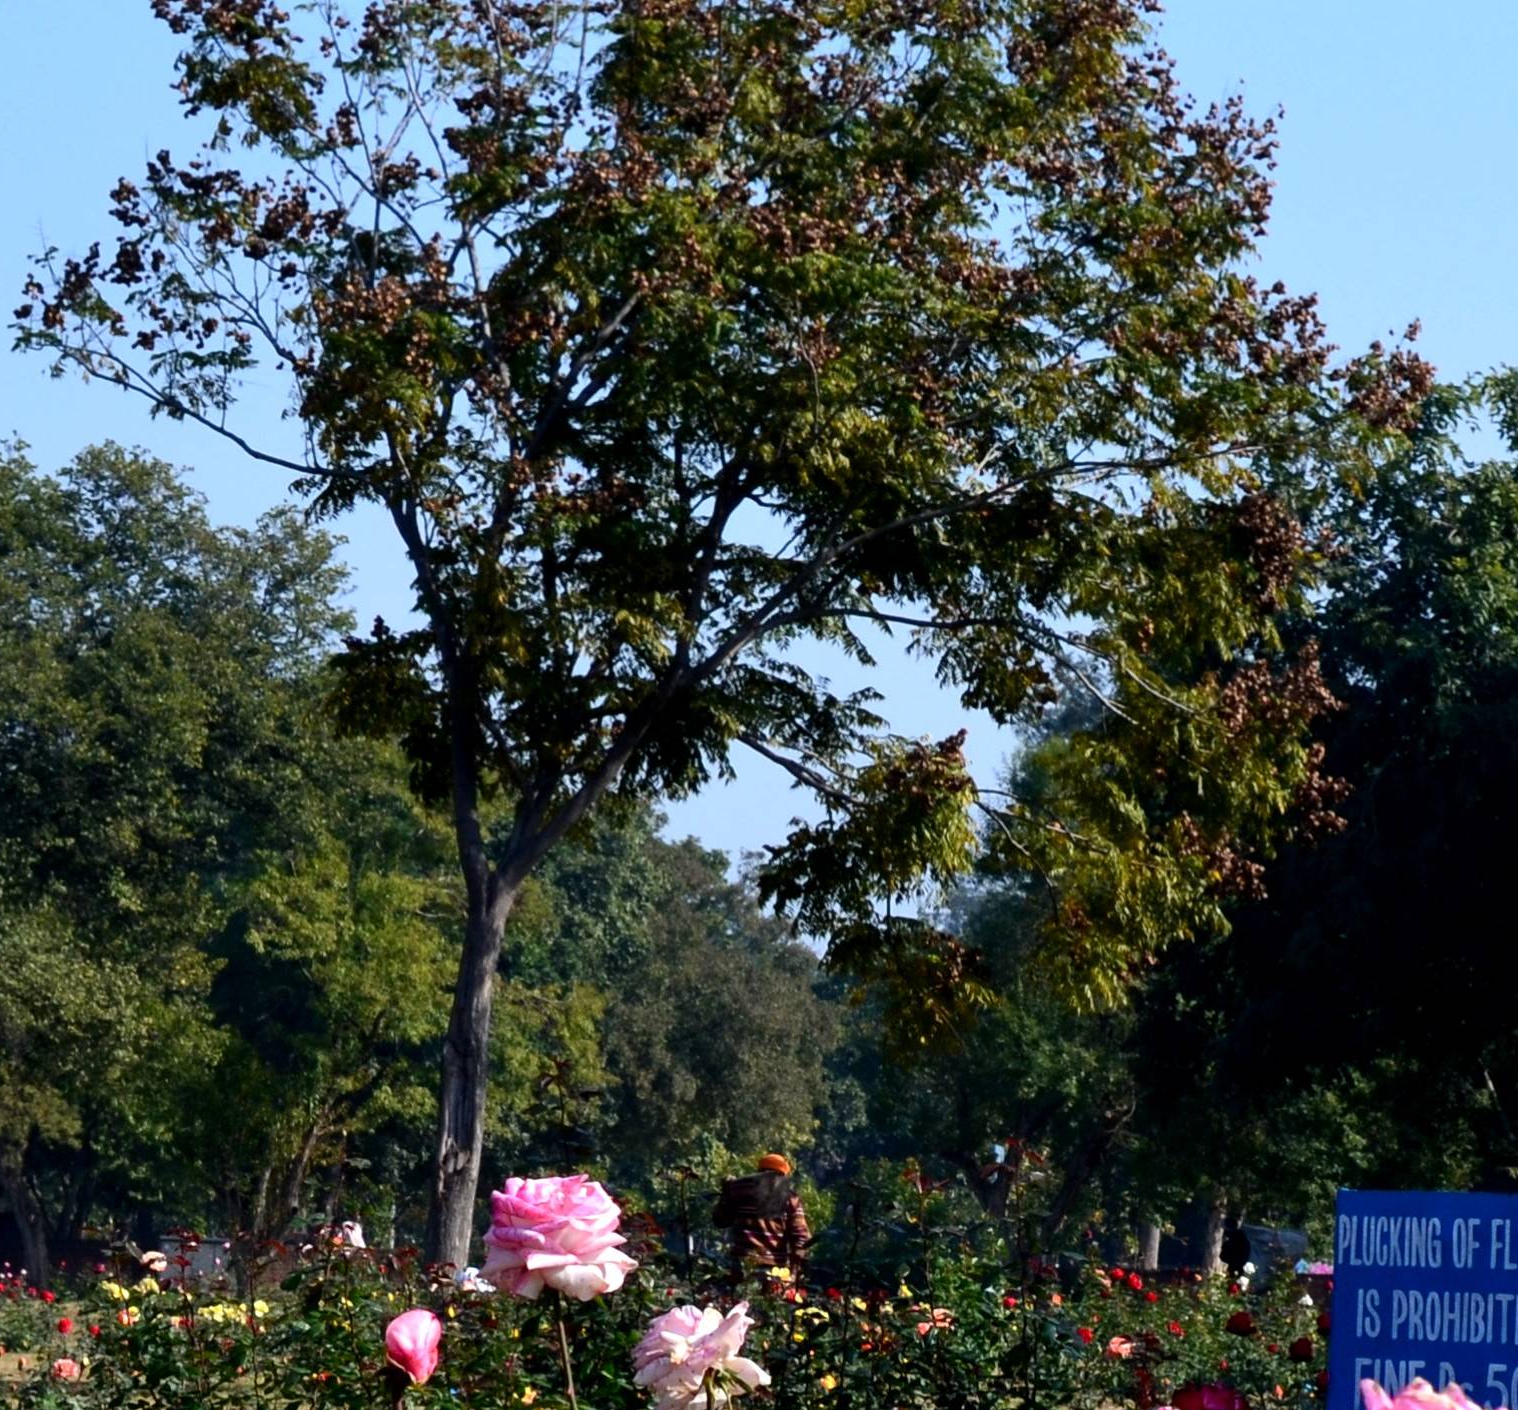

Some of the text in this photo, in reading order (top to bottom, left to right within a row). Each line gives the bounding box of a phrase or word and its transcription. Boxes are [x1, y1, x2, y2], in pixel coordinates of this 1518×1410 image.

[1337, 1213, 1442, 1269] PLUCKING
[1452, 1217, 1481, 1269] OF
[1356, 1288, 1381, 1338] IS
